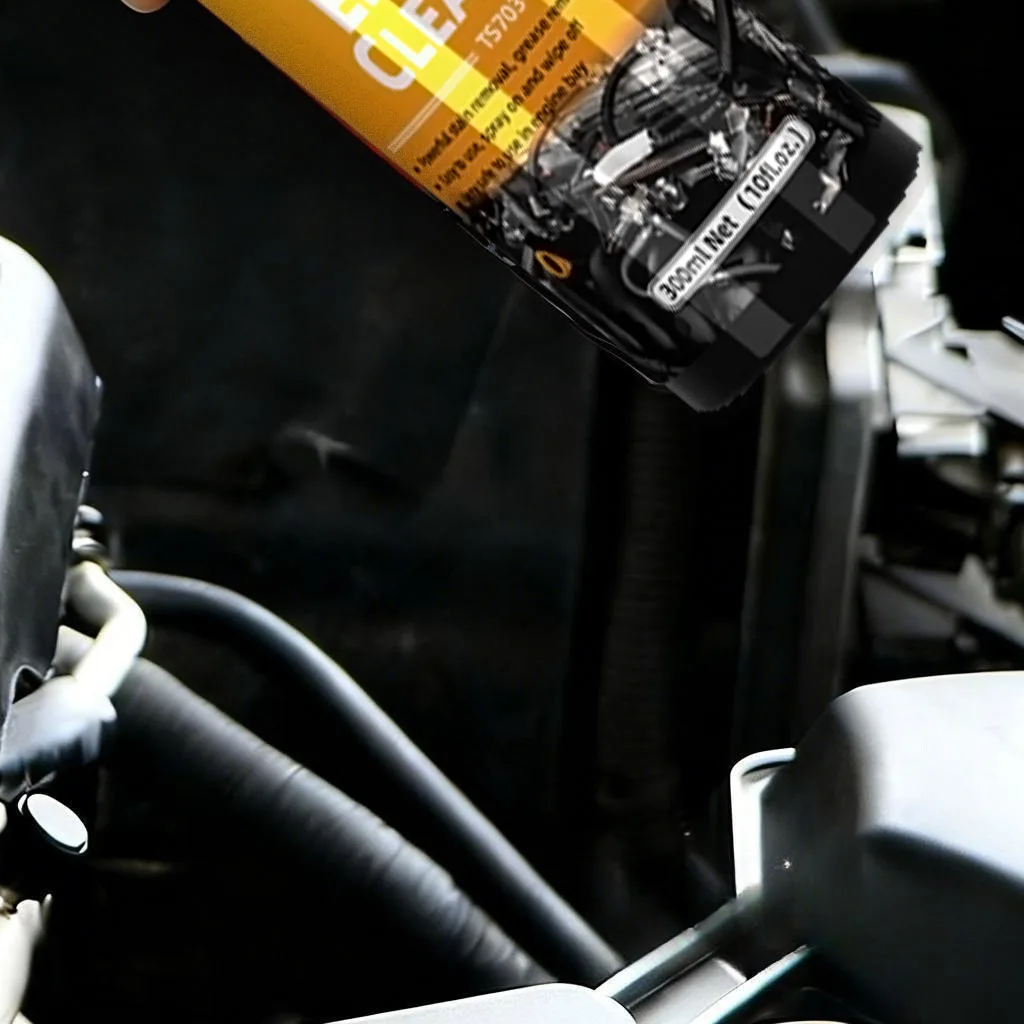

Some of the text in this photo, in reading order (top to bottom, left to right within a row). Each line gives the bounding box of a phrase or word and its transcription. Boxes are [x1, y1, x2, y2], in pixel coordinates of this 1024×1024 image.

[512, 17, 552, 65] grease
[506, 93, 525, 113] on
[521, 66, 545, 98] and
[539, 37, 570, 72] wipe
[561, 60, 589, 88] bay
[658, 244, 713, 302] 300ml
[703, 214, 740, 253] Net
